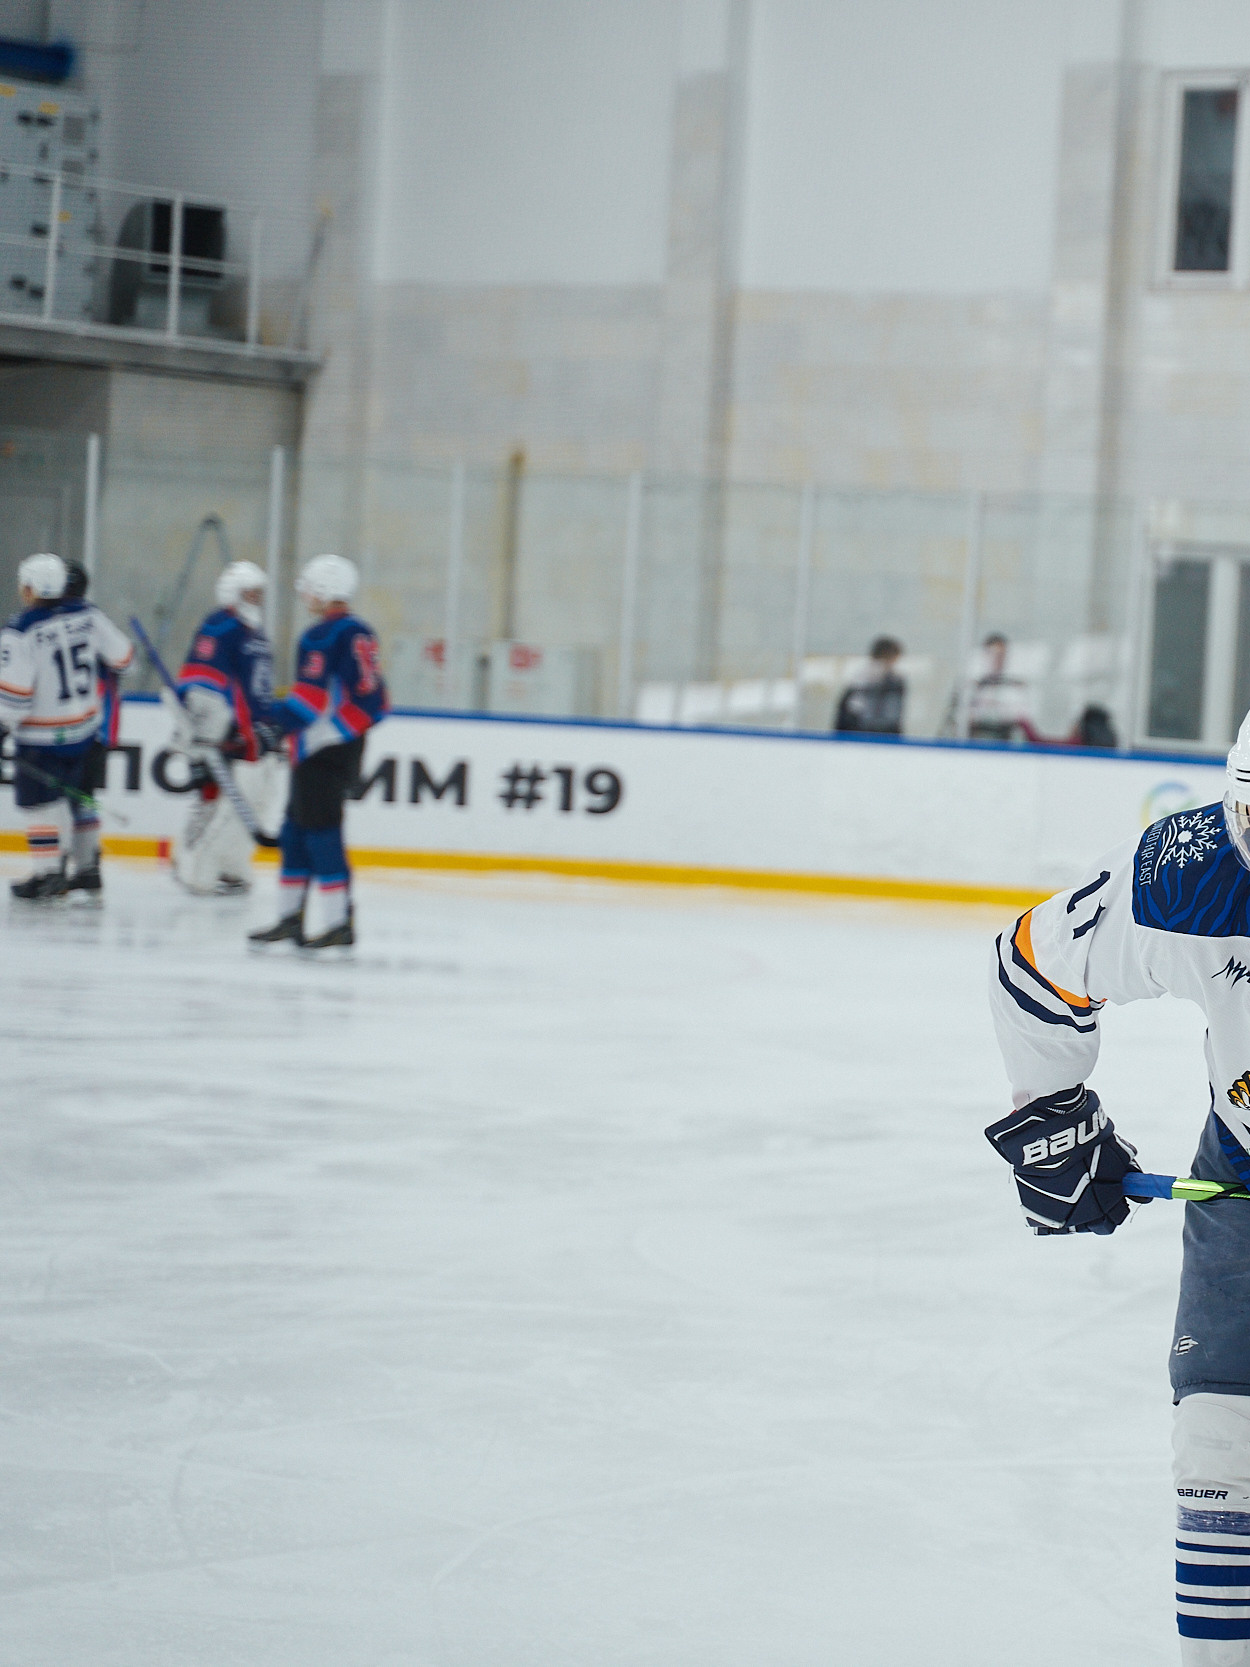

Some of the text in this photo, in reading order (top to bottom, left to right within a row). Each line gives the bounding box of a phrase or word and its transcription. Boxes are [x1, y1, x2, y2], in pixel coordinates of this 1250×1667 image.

[499, 764, 621, 815] #19
[1138, 860, 1152, 886] EAST
[1177, 1488, 1228, 1500] BAUER
